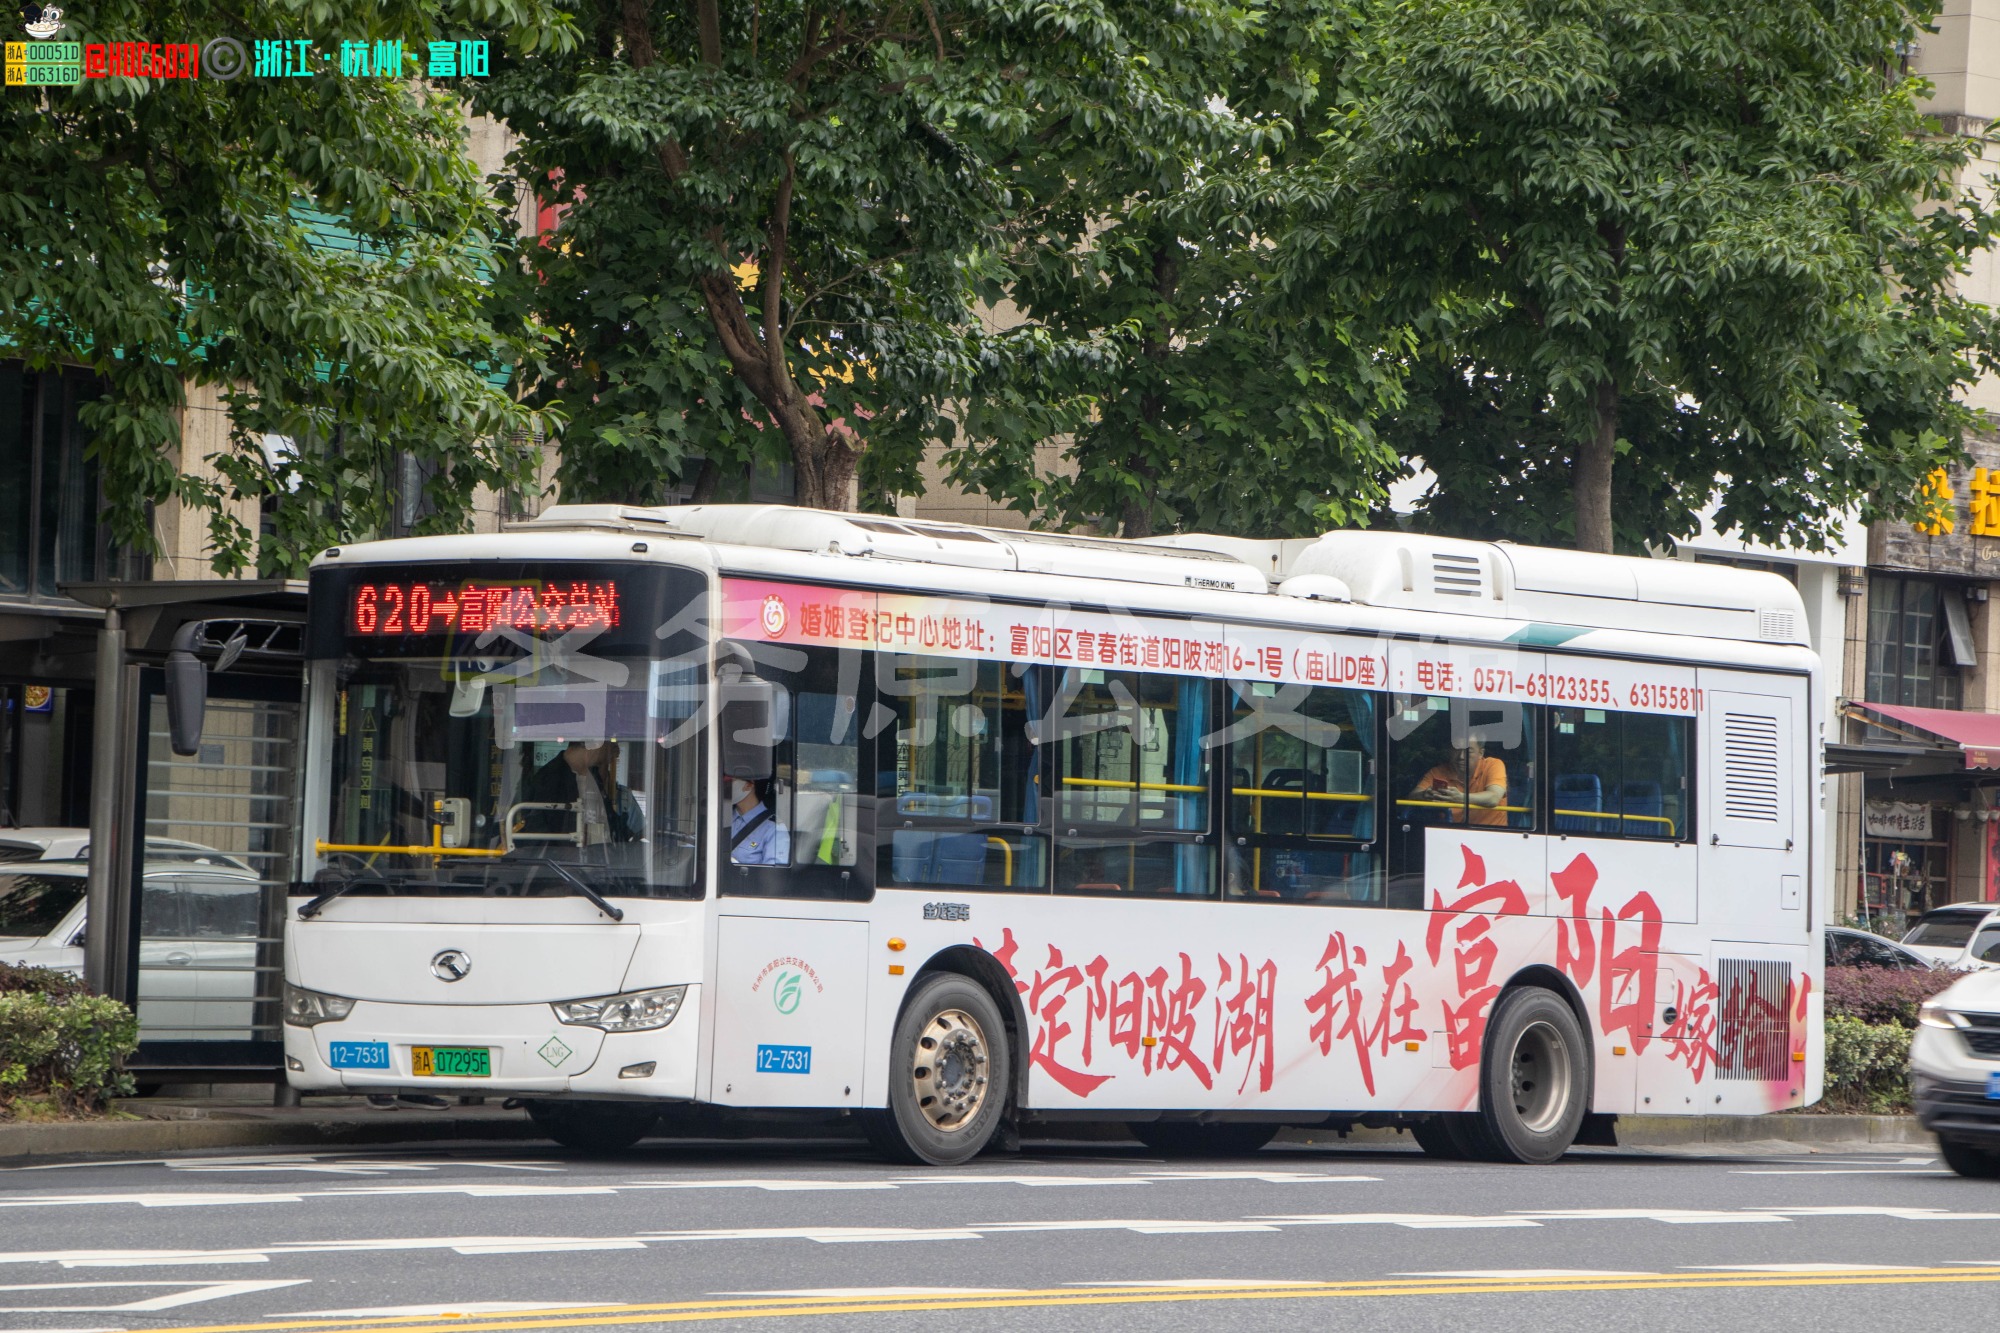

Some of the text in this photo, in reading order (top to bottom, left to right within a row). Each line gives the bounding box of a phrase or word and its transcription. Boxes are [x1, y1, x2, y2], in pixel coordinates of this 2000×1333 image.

[1194, 578, 1235, 590] THERMO KING
[356, 580, 621, 633] 620 富阳公交总站
[923, 902, 970, 921] 金龙客车
[332, 1045, 386, 1065] 12-7531
[546, 1047, 564, 1058] LNG
[758, 1049, 808, 1070] 12-7531
